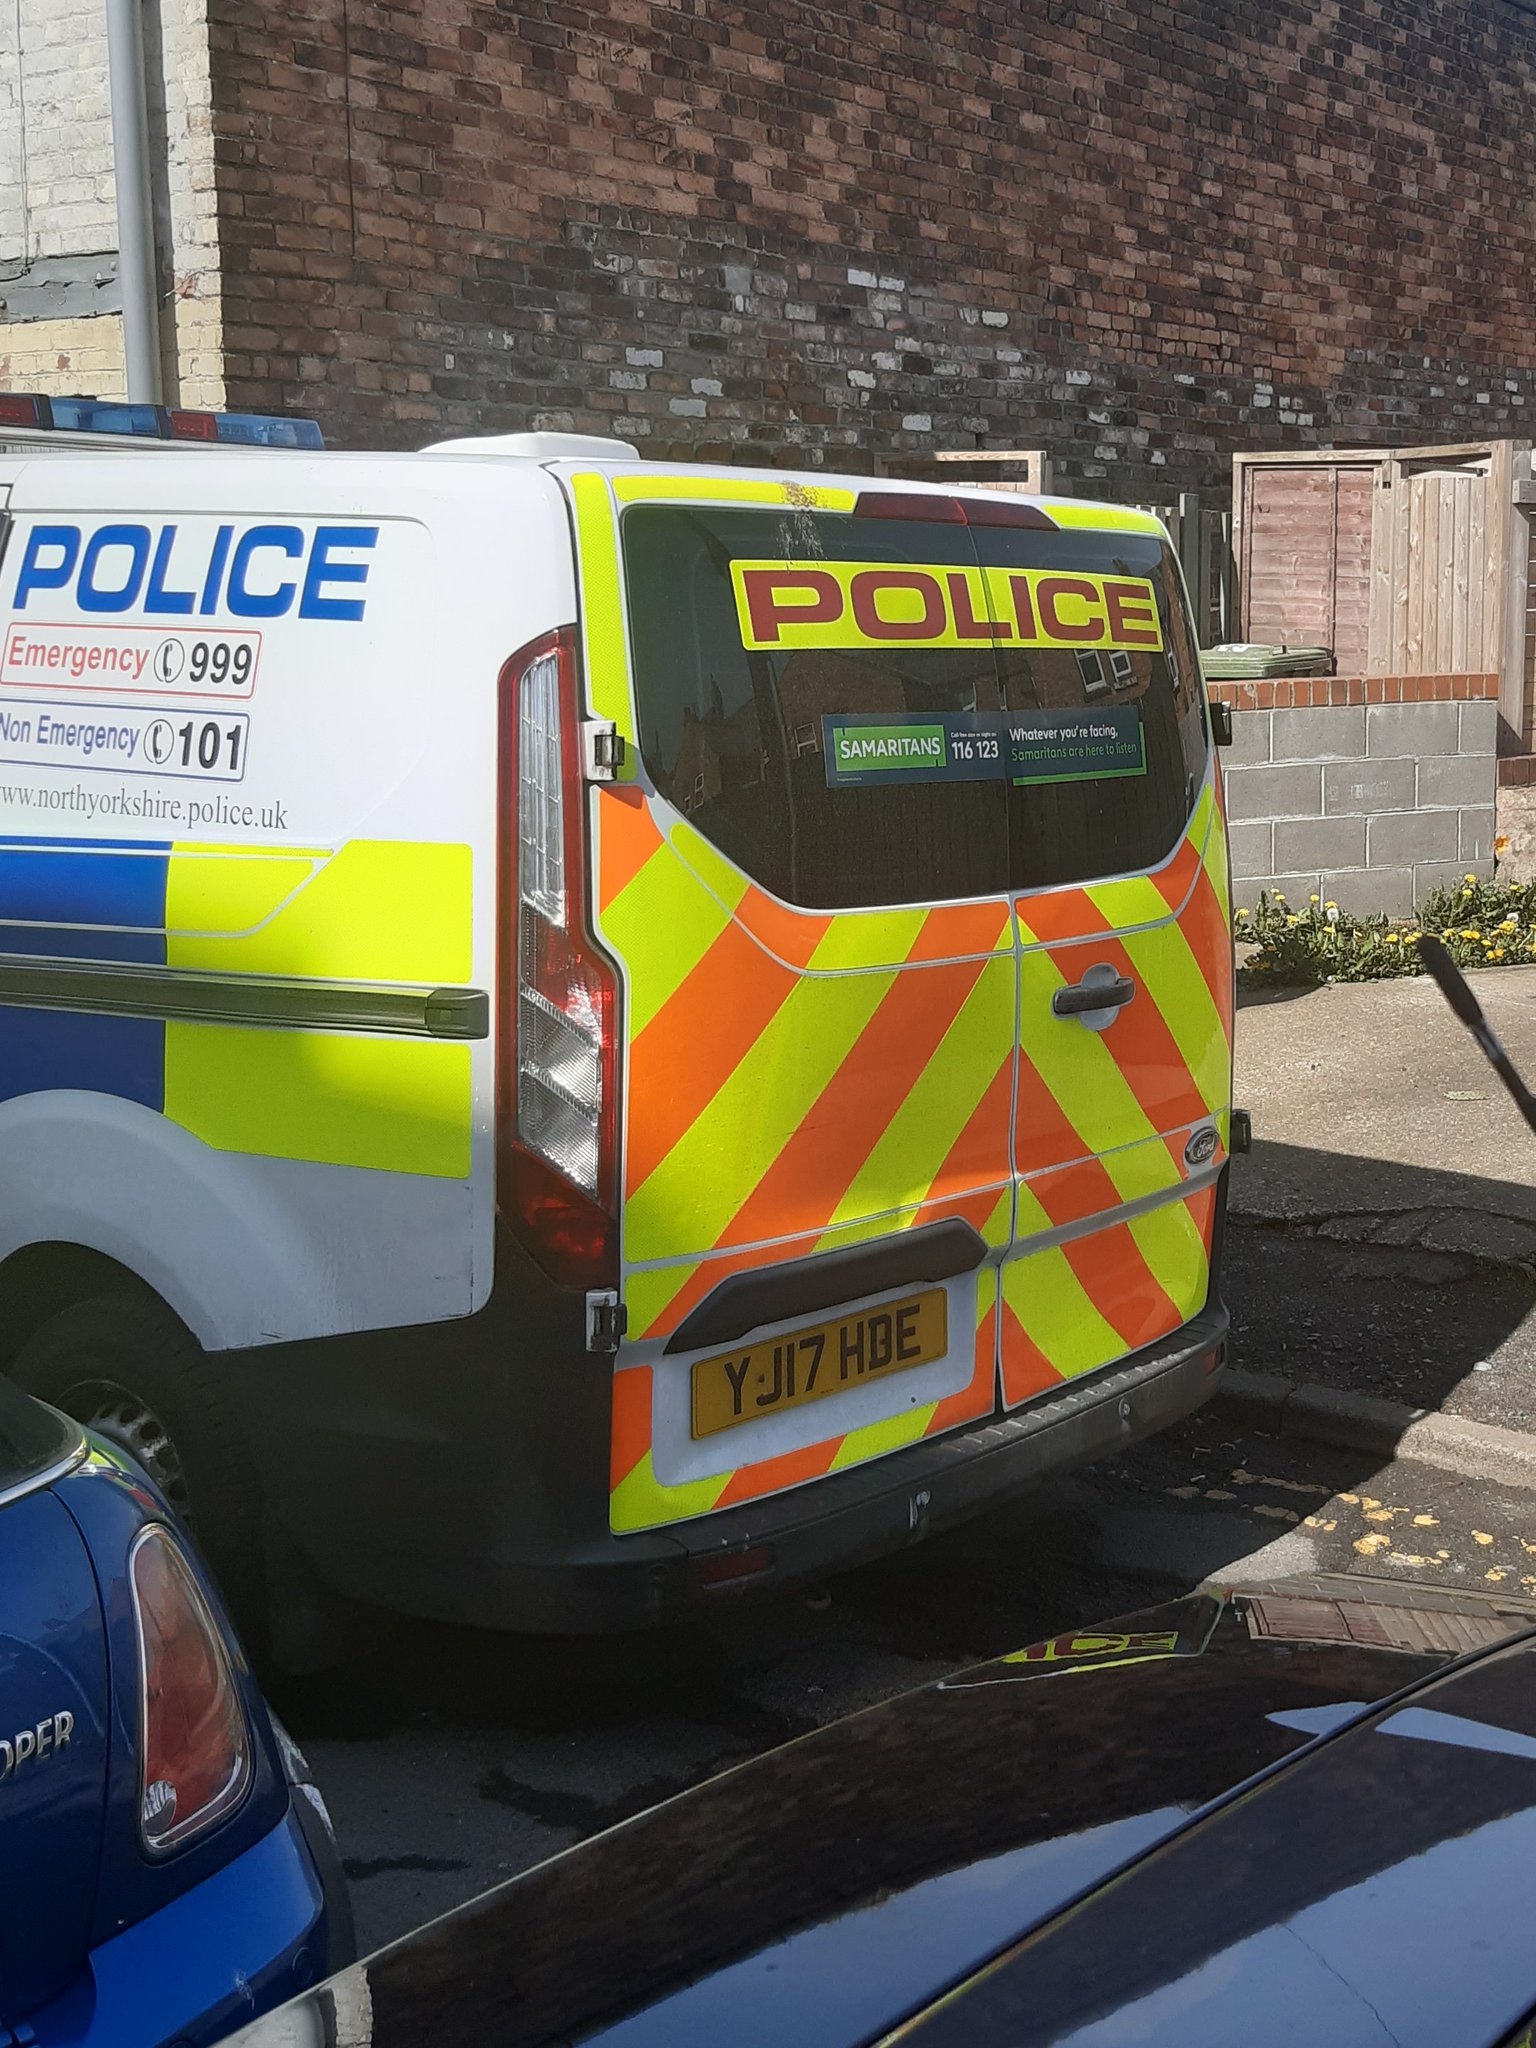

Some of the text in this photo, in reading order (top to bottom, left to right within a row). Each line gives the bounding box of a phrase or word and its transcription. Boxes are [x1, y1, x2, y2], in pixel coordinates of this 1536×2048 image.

[12, 524, 380, 621] POLICE
[743, 570, 1159, 645] POLICE
[8, 636, 252, 684] Emergency 999
[37, 715, 140, 758] Emergency
[178, 722, 242, 770] 101
[840, 737, 941, 759] SAMARITANS
[951, 740, 999, 760] 116 123
[1009, 727, 1057, 742] Whatever
[1060, 725, 1088, 742] you're
[1089, 724, 1118, 739] facing,
[1012, 742, 1137, 761] Samaritans are here to listen
[0, 784, 288, 830] ww.northyorkshire.police.uk
[840, 1304, 920, 1380] HDE
